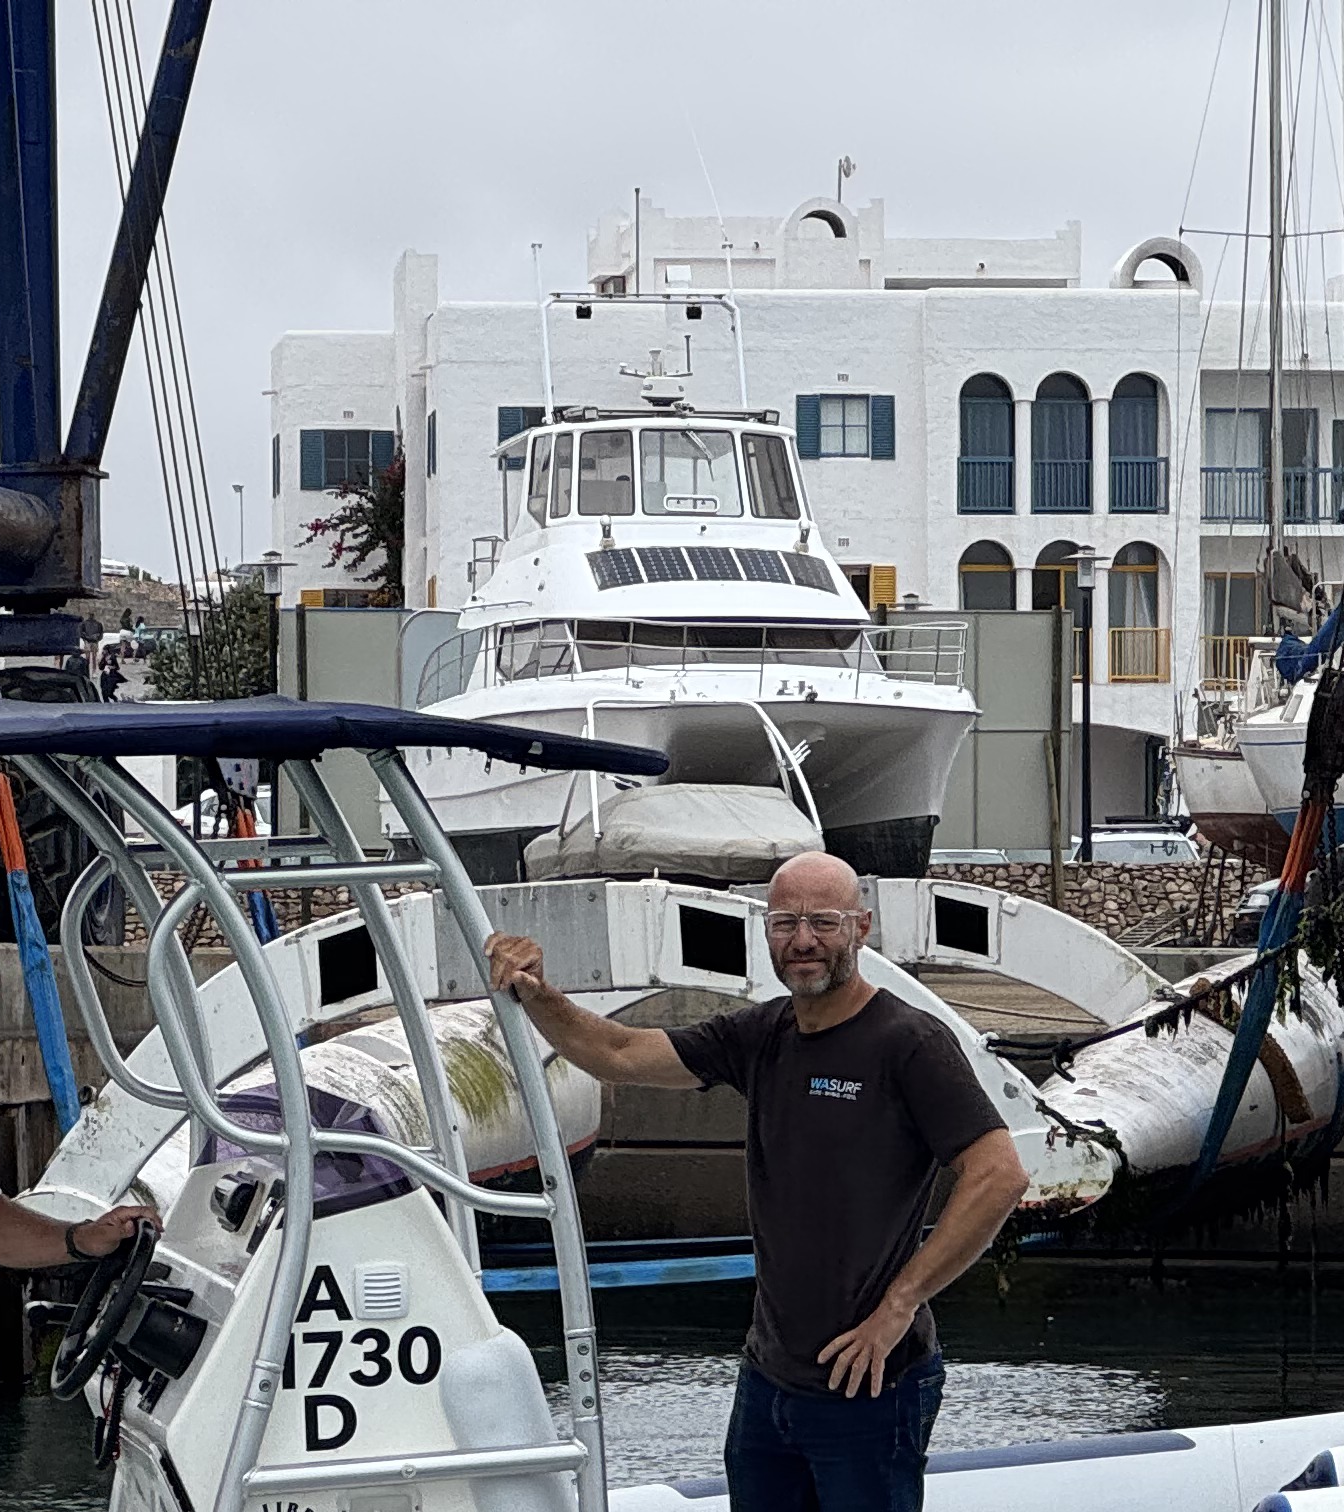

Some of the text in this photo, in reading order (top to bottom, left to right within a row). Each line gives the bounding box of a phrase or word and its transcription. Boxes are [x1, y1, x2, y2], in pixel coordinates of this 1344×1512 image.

[294, 1264, 354, 1324] A
[282, 1325, 442, 1390] 1730
[304, 1394, 358, 1453] D
